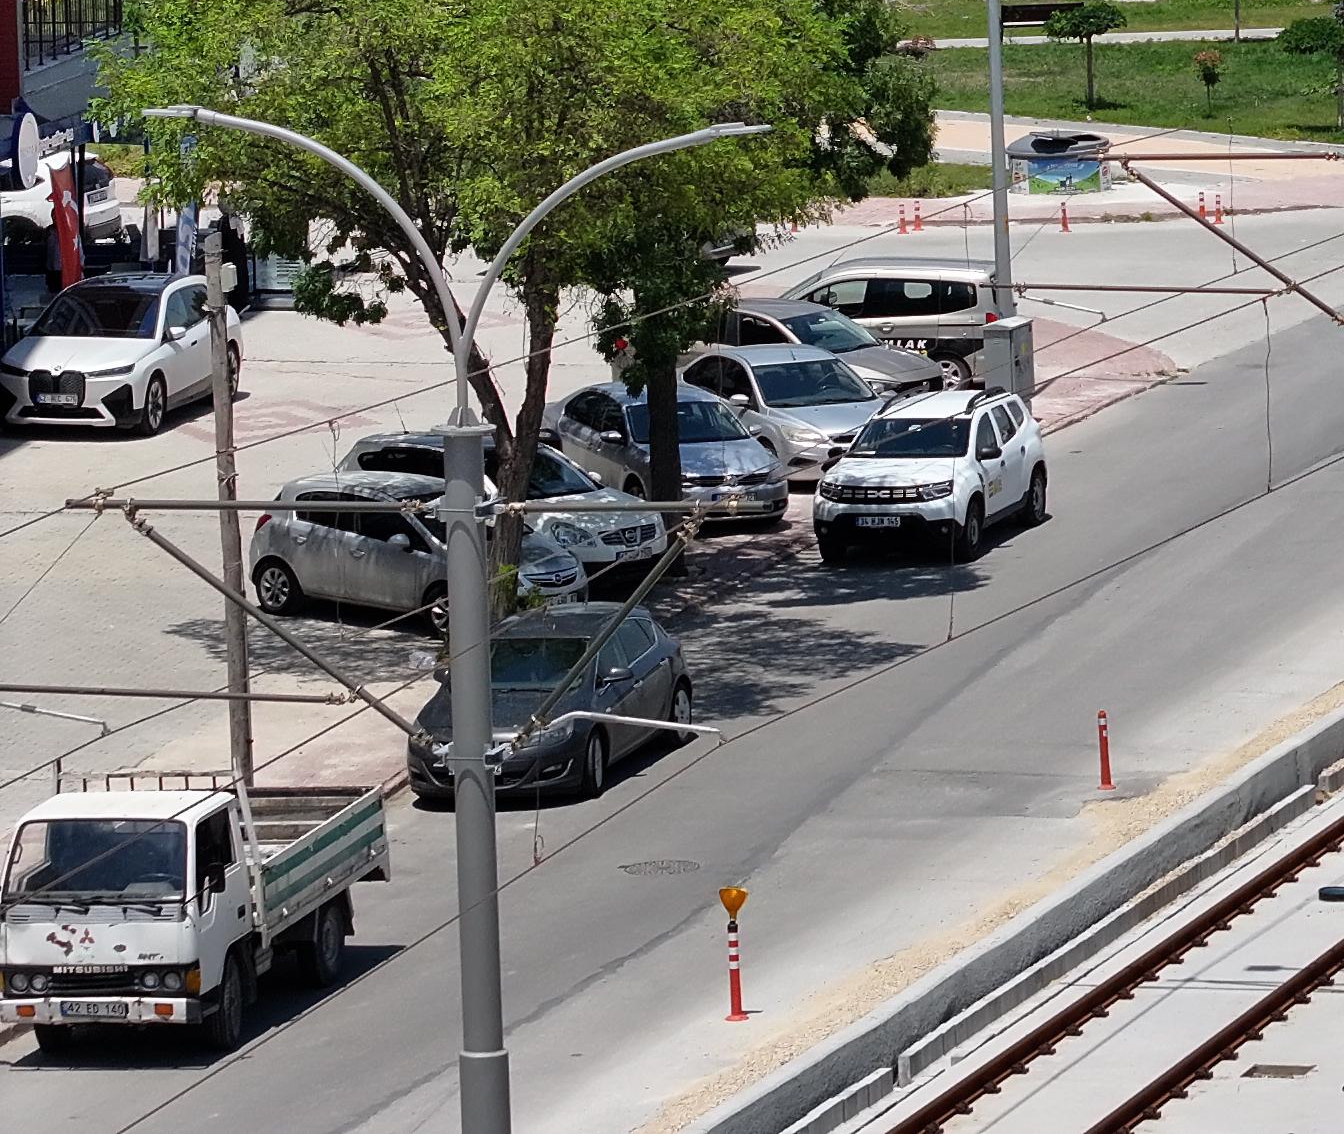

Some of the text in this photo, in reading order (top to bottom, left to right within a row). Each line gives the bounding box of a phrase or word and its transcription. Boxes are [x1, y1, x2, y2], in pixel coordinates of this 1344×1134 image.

[68, 1003, 124, 1014] 42 ED 140
